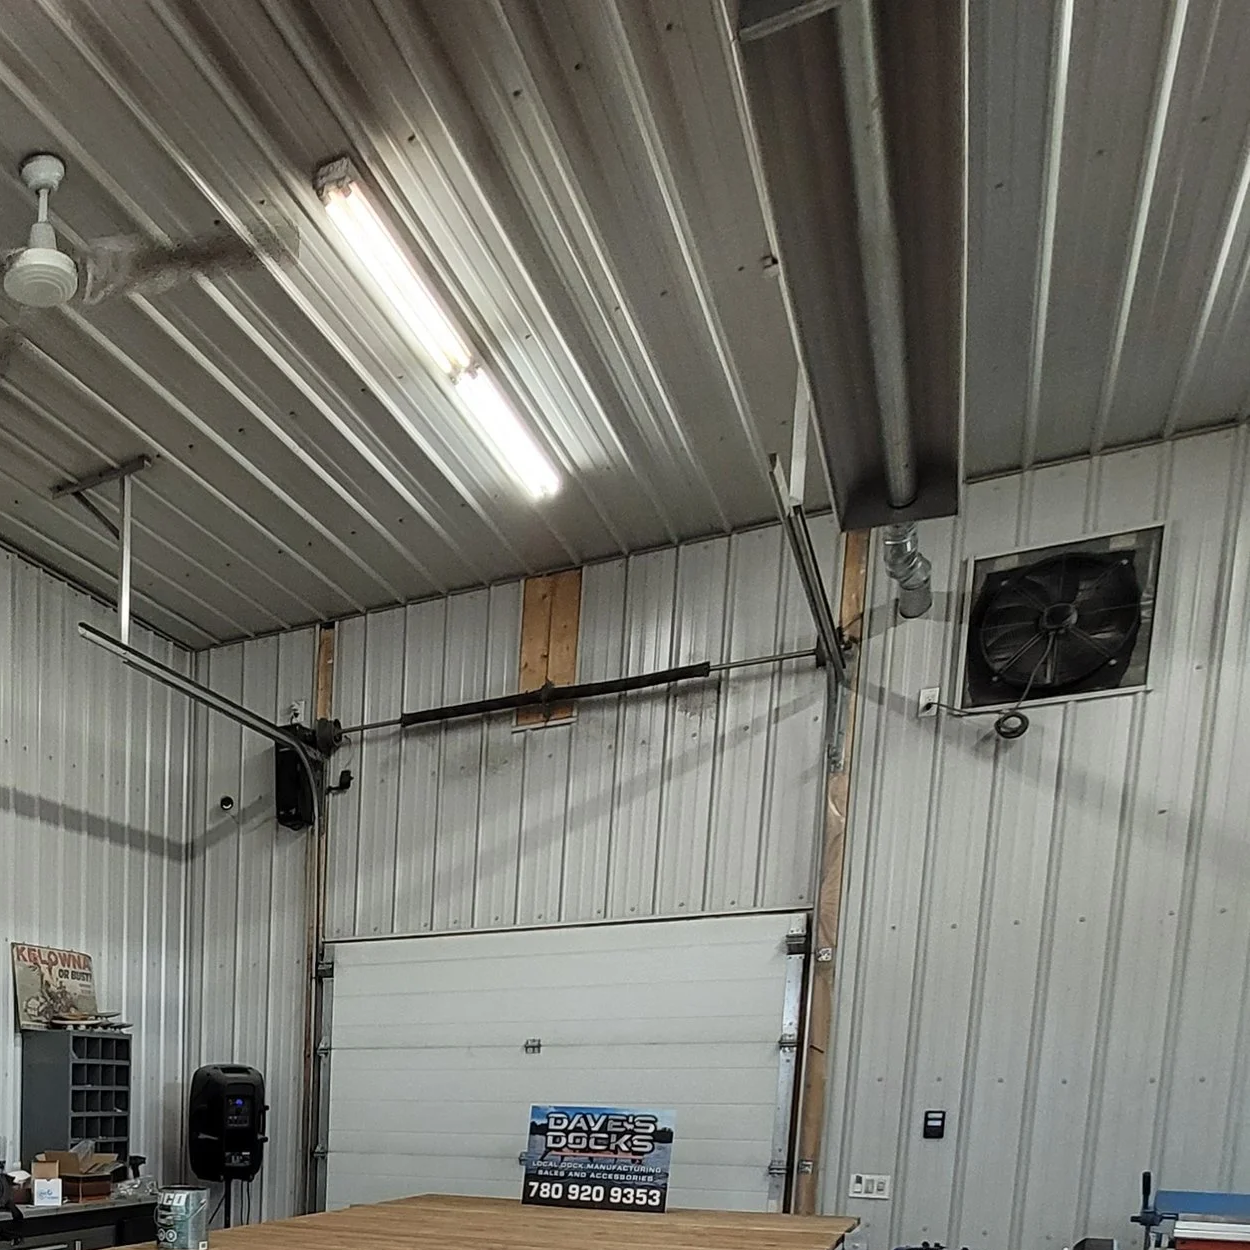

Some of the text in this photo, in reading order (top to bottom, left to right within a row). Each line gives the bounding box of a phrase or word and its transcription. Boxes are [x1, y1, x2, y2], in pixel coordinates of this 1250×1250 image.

[16, 946, 91, 971] KELOWNA
[58, 968, 70, 979] OR
[547, 1112, 656, 1133] DAVE'S
[545, 1131, 655, 1152] DOCKS
[532, 1160, 662, 1174] LOCAL DOCK MANUFACTURING
[537, 1169, 654, 1183] SALES AND ACCESSORIES
[528, 1181, 661, 1207] 780 920 9353
